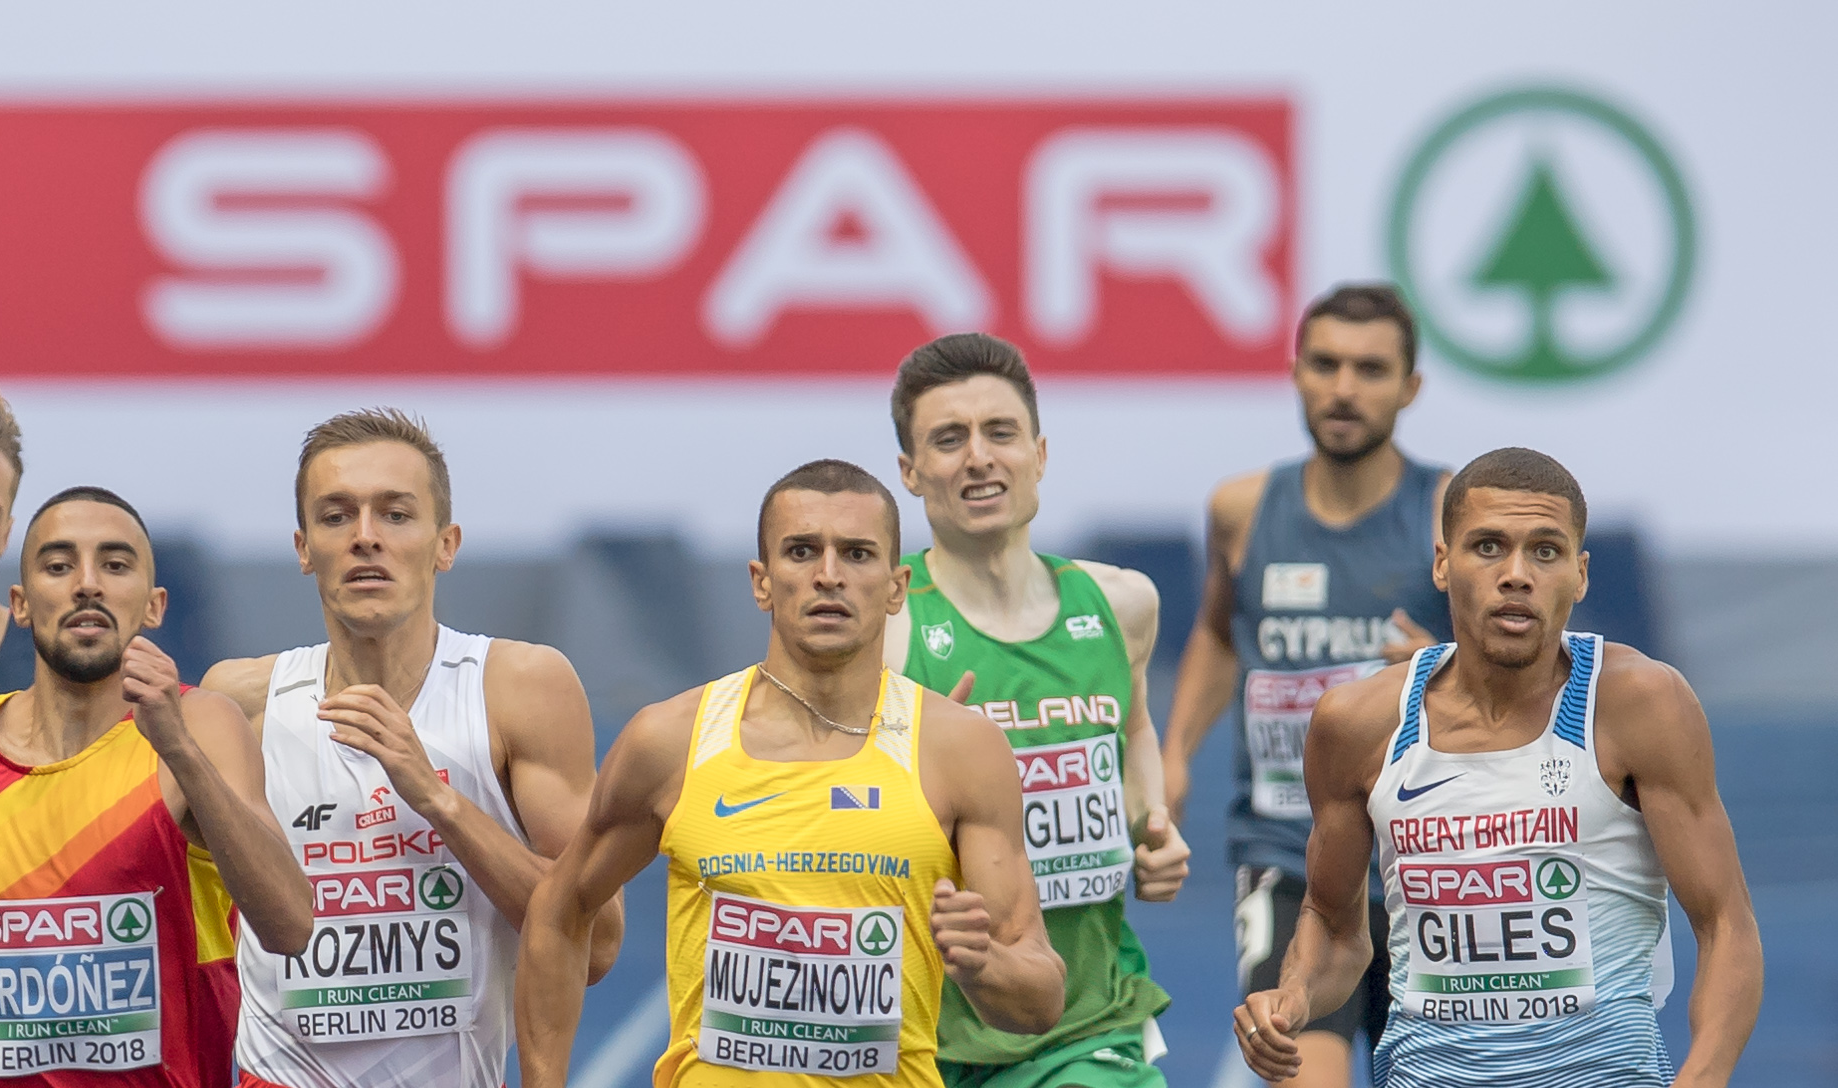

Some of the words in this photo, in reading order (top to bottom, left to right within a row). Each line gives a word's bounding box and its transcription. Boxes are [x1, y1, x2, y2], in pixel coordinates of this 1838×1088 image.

[140, 128, 1282, 349] SPAR
[965, 696, 1120, 729] ELAND
[1017, 752, 1088, 788] AR
[292, 803, 337, 830] 4F
[358, 808, 393, 827] ORLEN
[1025, 788, 1121, 848] GLISH
[1390, 815, 1471, 854] GREAT
[1473, 806, 1578, 850] BRITAIN
[698, 852, 910, 879] BOSNIA-HERZEGOVINA
[312, 874, 410, 912] PAR
[1079, 871, 1123, 897] 2018
[1402, 866, 1528, 900] SPAR
[716, 905, 848, 949] SPAR
[1417, 907, 1576, 963] GILES
[318, 989, 323, 1004] I
[327, 987, 363, 1003] RUN
[710, 949, 894, 1015] MUJEZINOVIC
[1442, 978, 1446, 991] I
[1451, 976, 1486, 991] RUN
[297, 1009, 386, 1037] BERLIN
[395, 1005, 457, 1030] 2018
[1422, 997, 1510, 1022] BERLIN
[1517, 994, 1580, 1019] 2018
[8, 1025, 12, 1038] I
[16, 1022, 51, 1037] RUN
[741, 1019, 746, 1032] I
[751, 1020, 790, 1037] RUN
[85, 1038, 145, 1064] 2018
[716, 1036, 808, 1069] BERLIN
[818, 1047, 879, 1071] 2018
